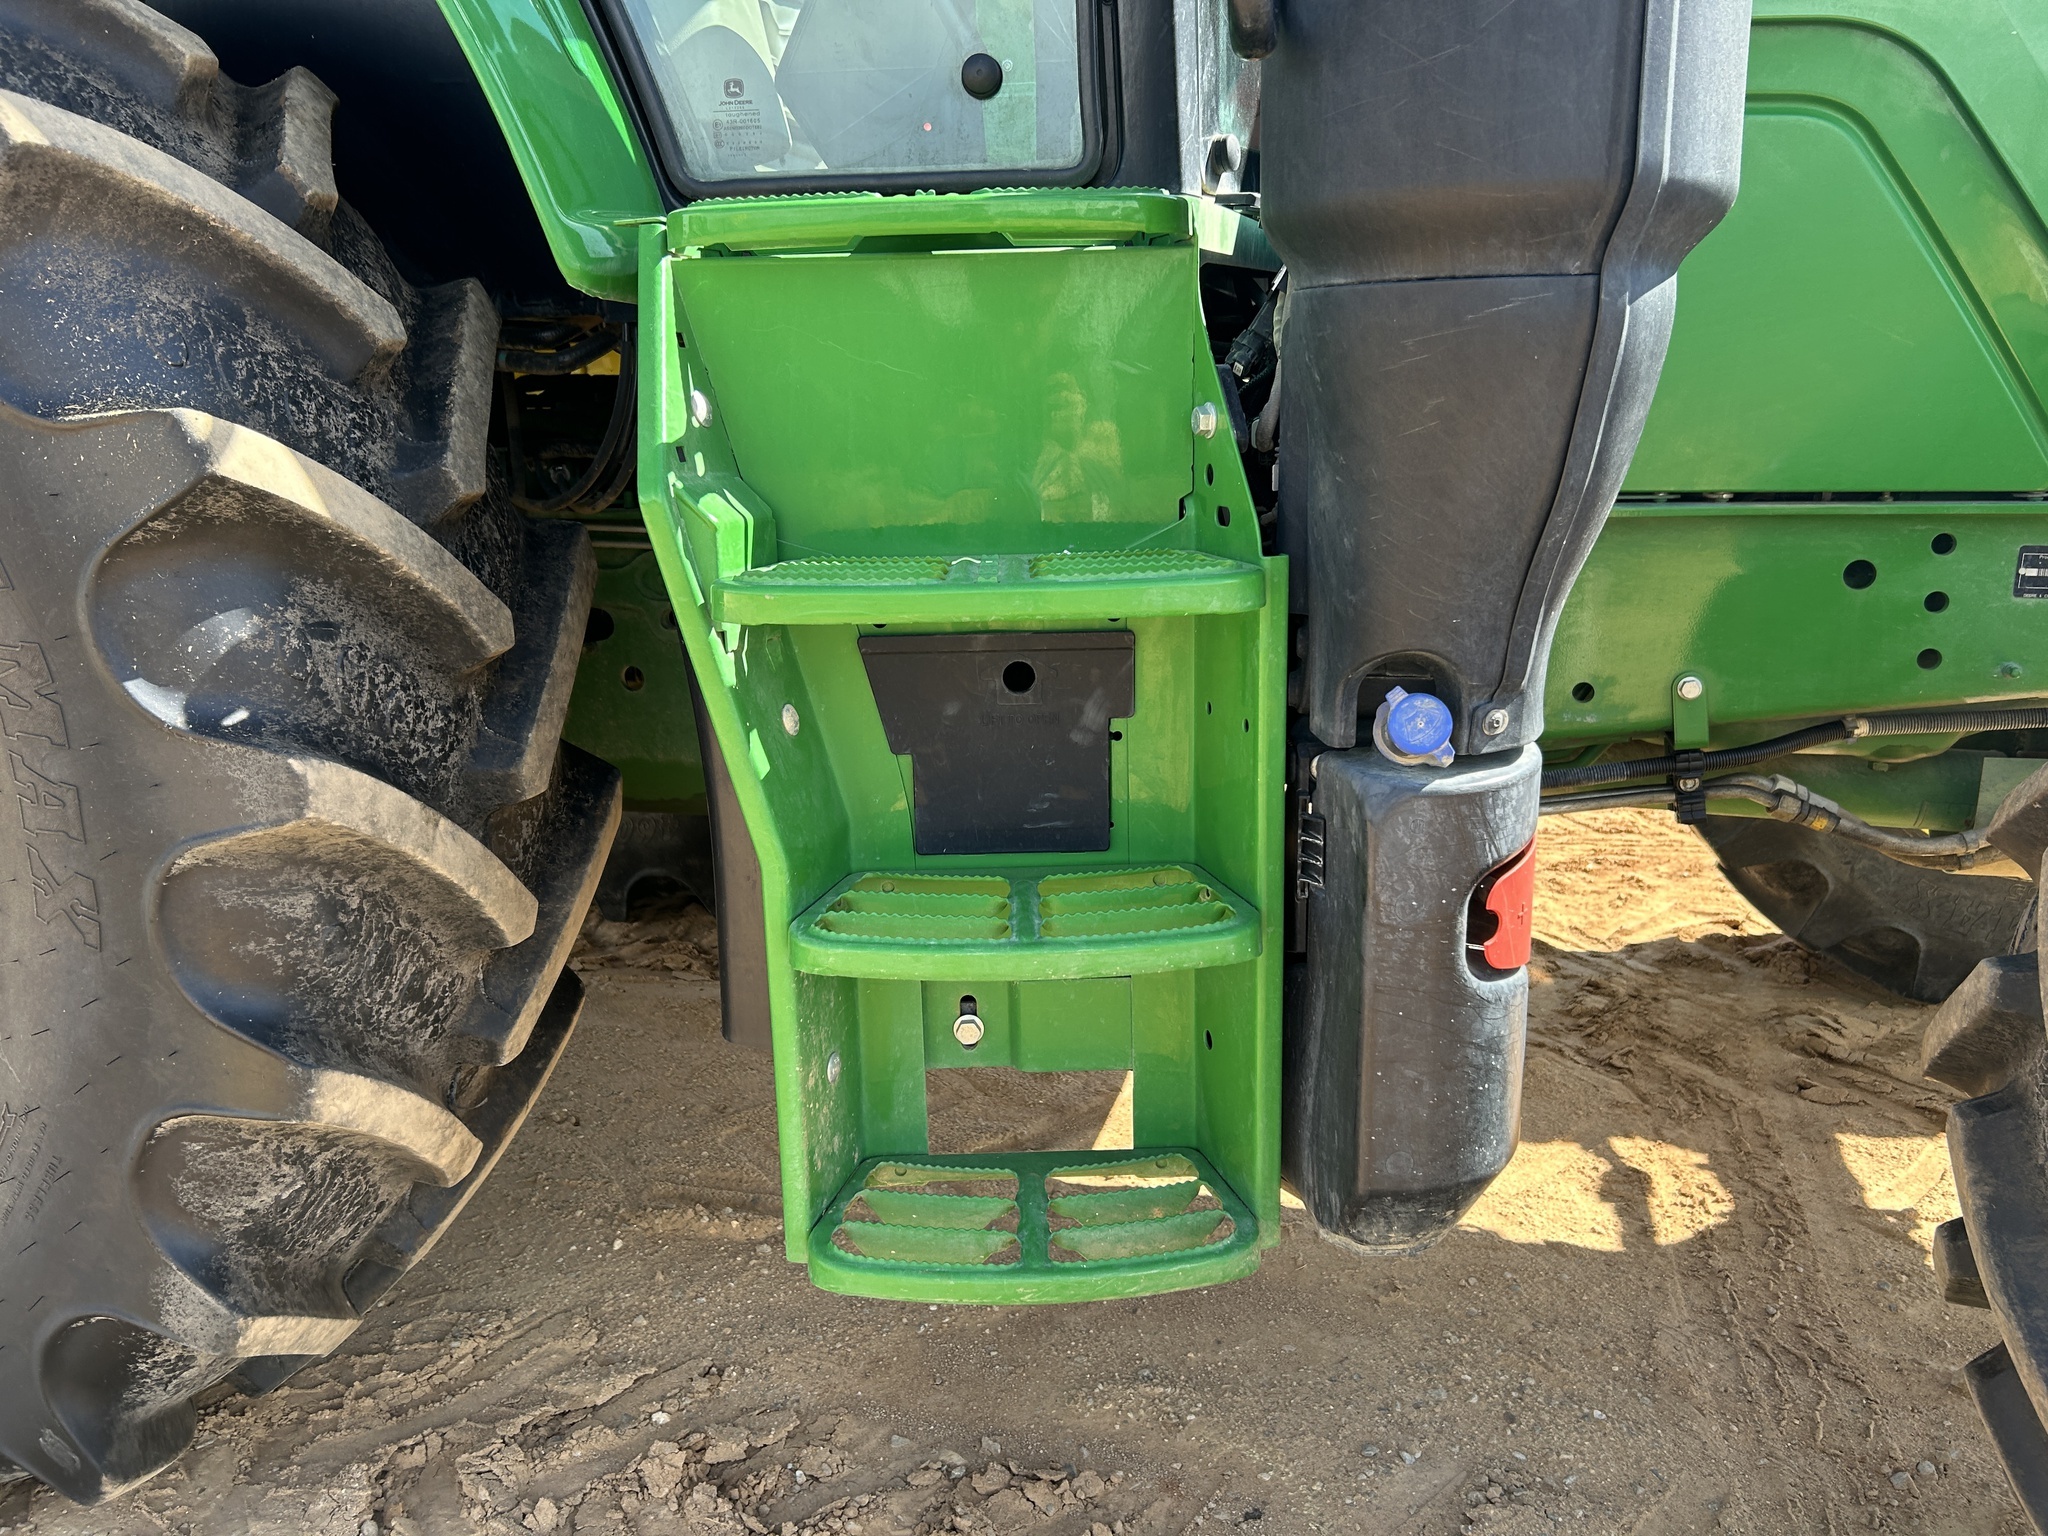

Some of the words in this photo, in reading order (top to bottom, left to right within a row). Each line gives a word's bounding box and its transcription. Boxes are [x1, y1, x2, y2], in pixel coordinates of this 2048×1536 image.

[1007, 714, 1024, 726] TO
[1027, 712, 1060, 726] OPEN
[24, 1154, 62, 1221] TUBELESS
